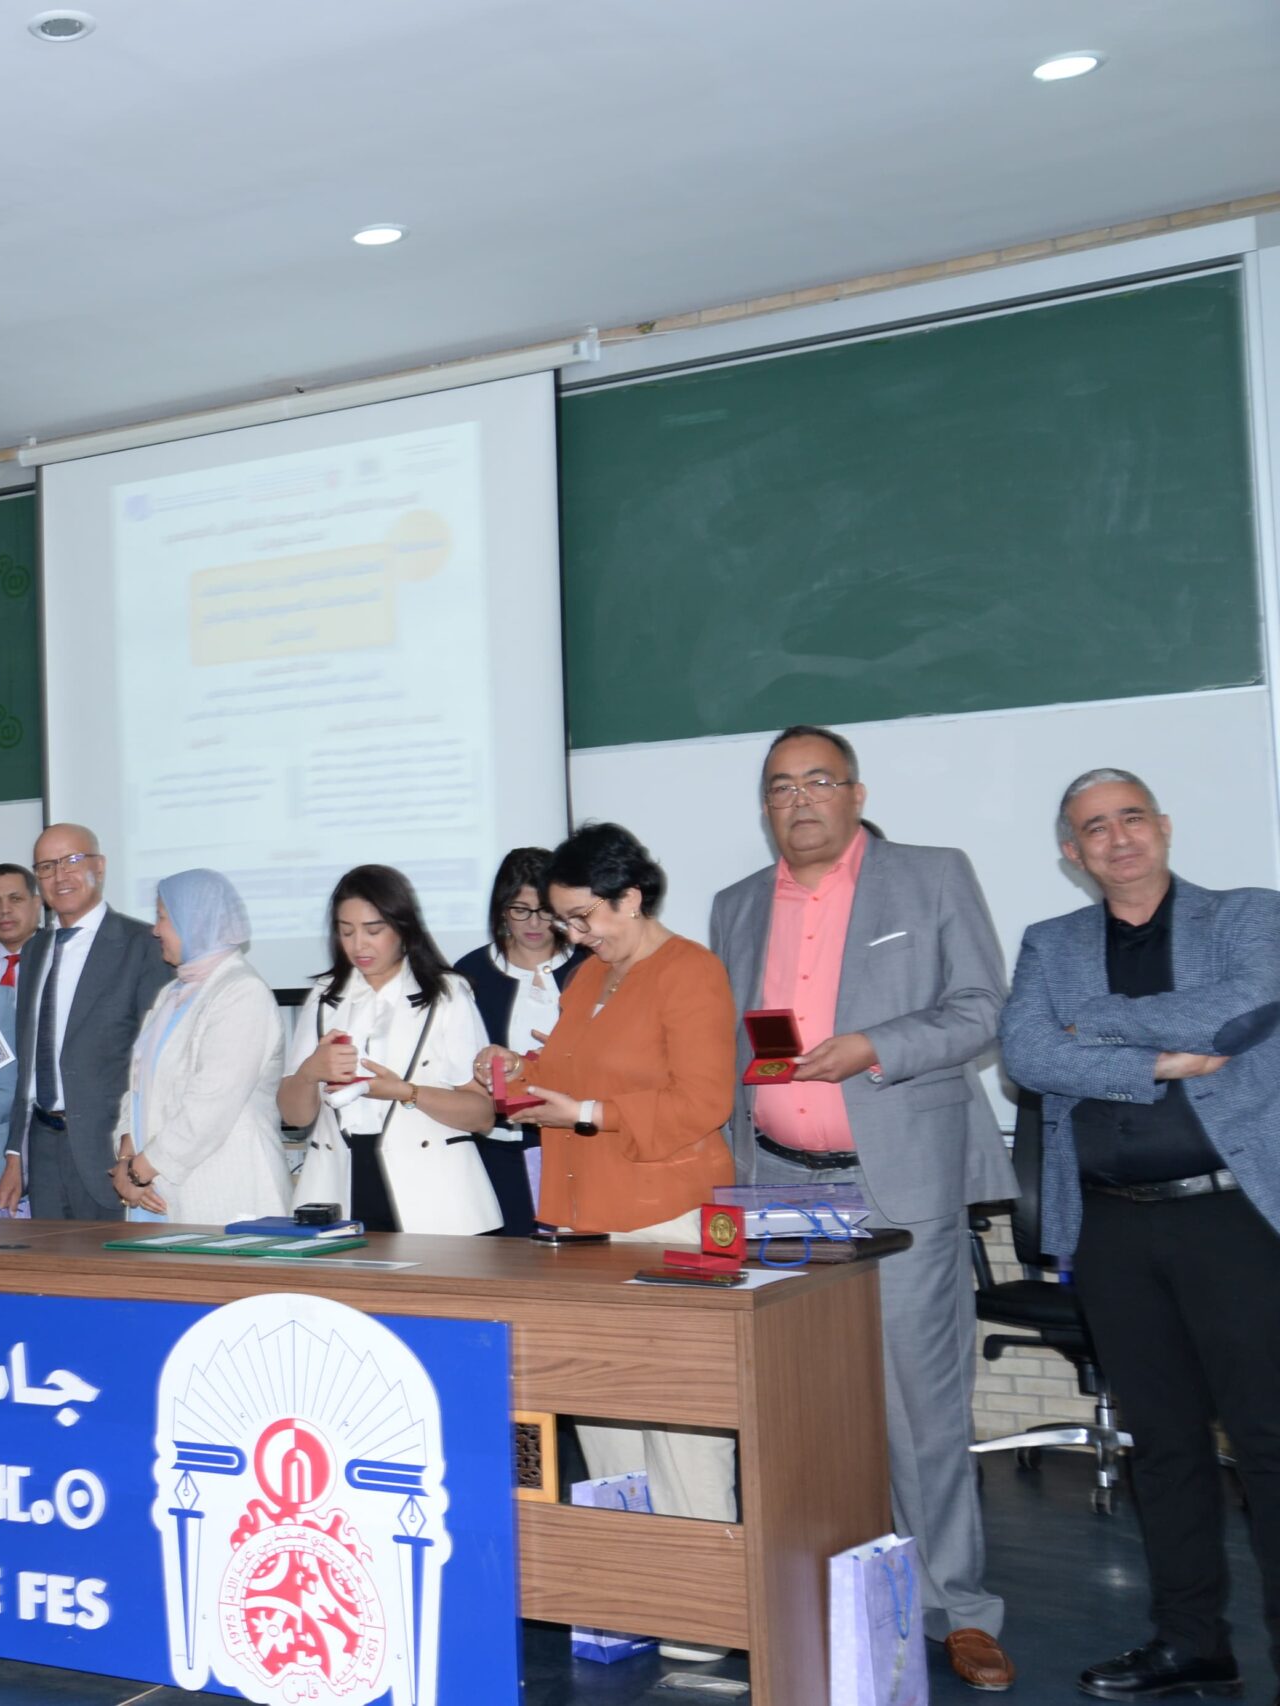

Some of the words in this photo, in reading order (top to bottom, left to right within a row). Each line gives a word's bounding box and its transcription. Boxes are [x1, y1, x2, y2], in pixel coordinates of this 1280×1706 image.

[18, 1571, 110, 1629] FES
[225, 1613, 242, 1646] 1975
[362, 1638, 380, 1669] 1395
